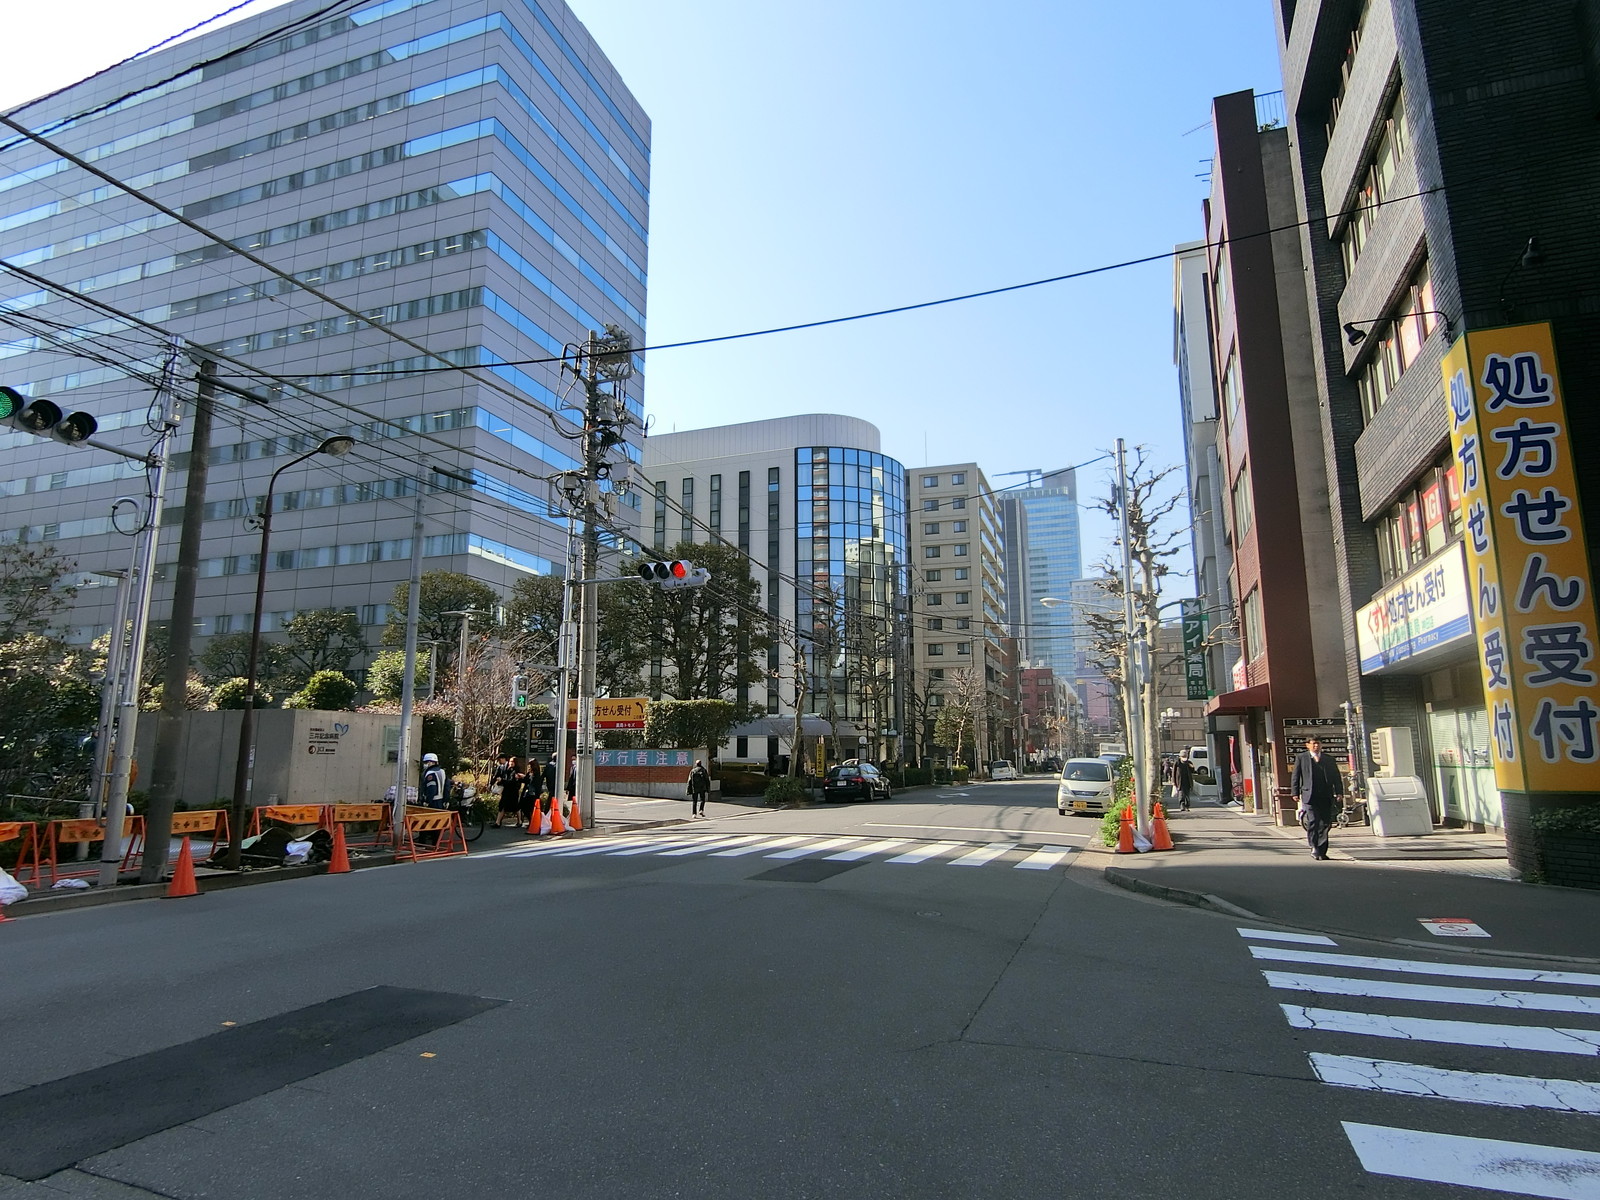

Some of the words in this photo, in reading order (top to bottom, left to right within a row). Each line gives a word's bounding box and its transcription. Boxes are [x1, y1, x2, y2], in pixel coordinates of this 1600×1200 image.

[1451, 371, 1514, 760] 処方せん受付
[1485, 354, 1600, 760] 処方せん受付
[598, 751, 689, 766] 歩行者注意
